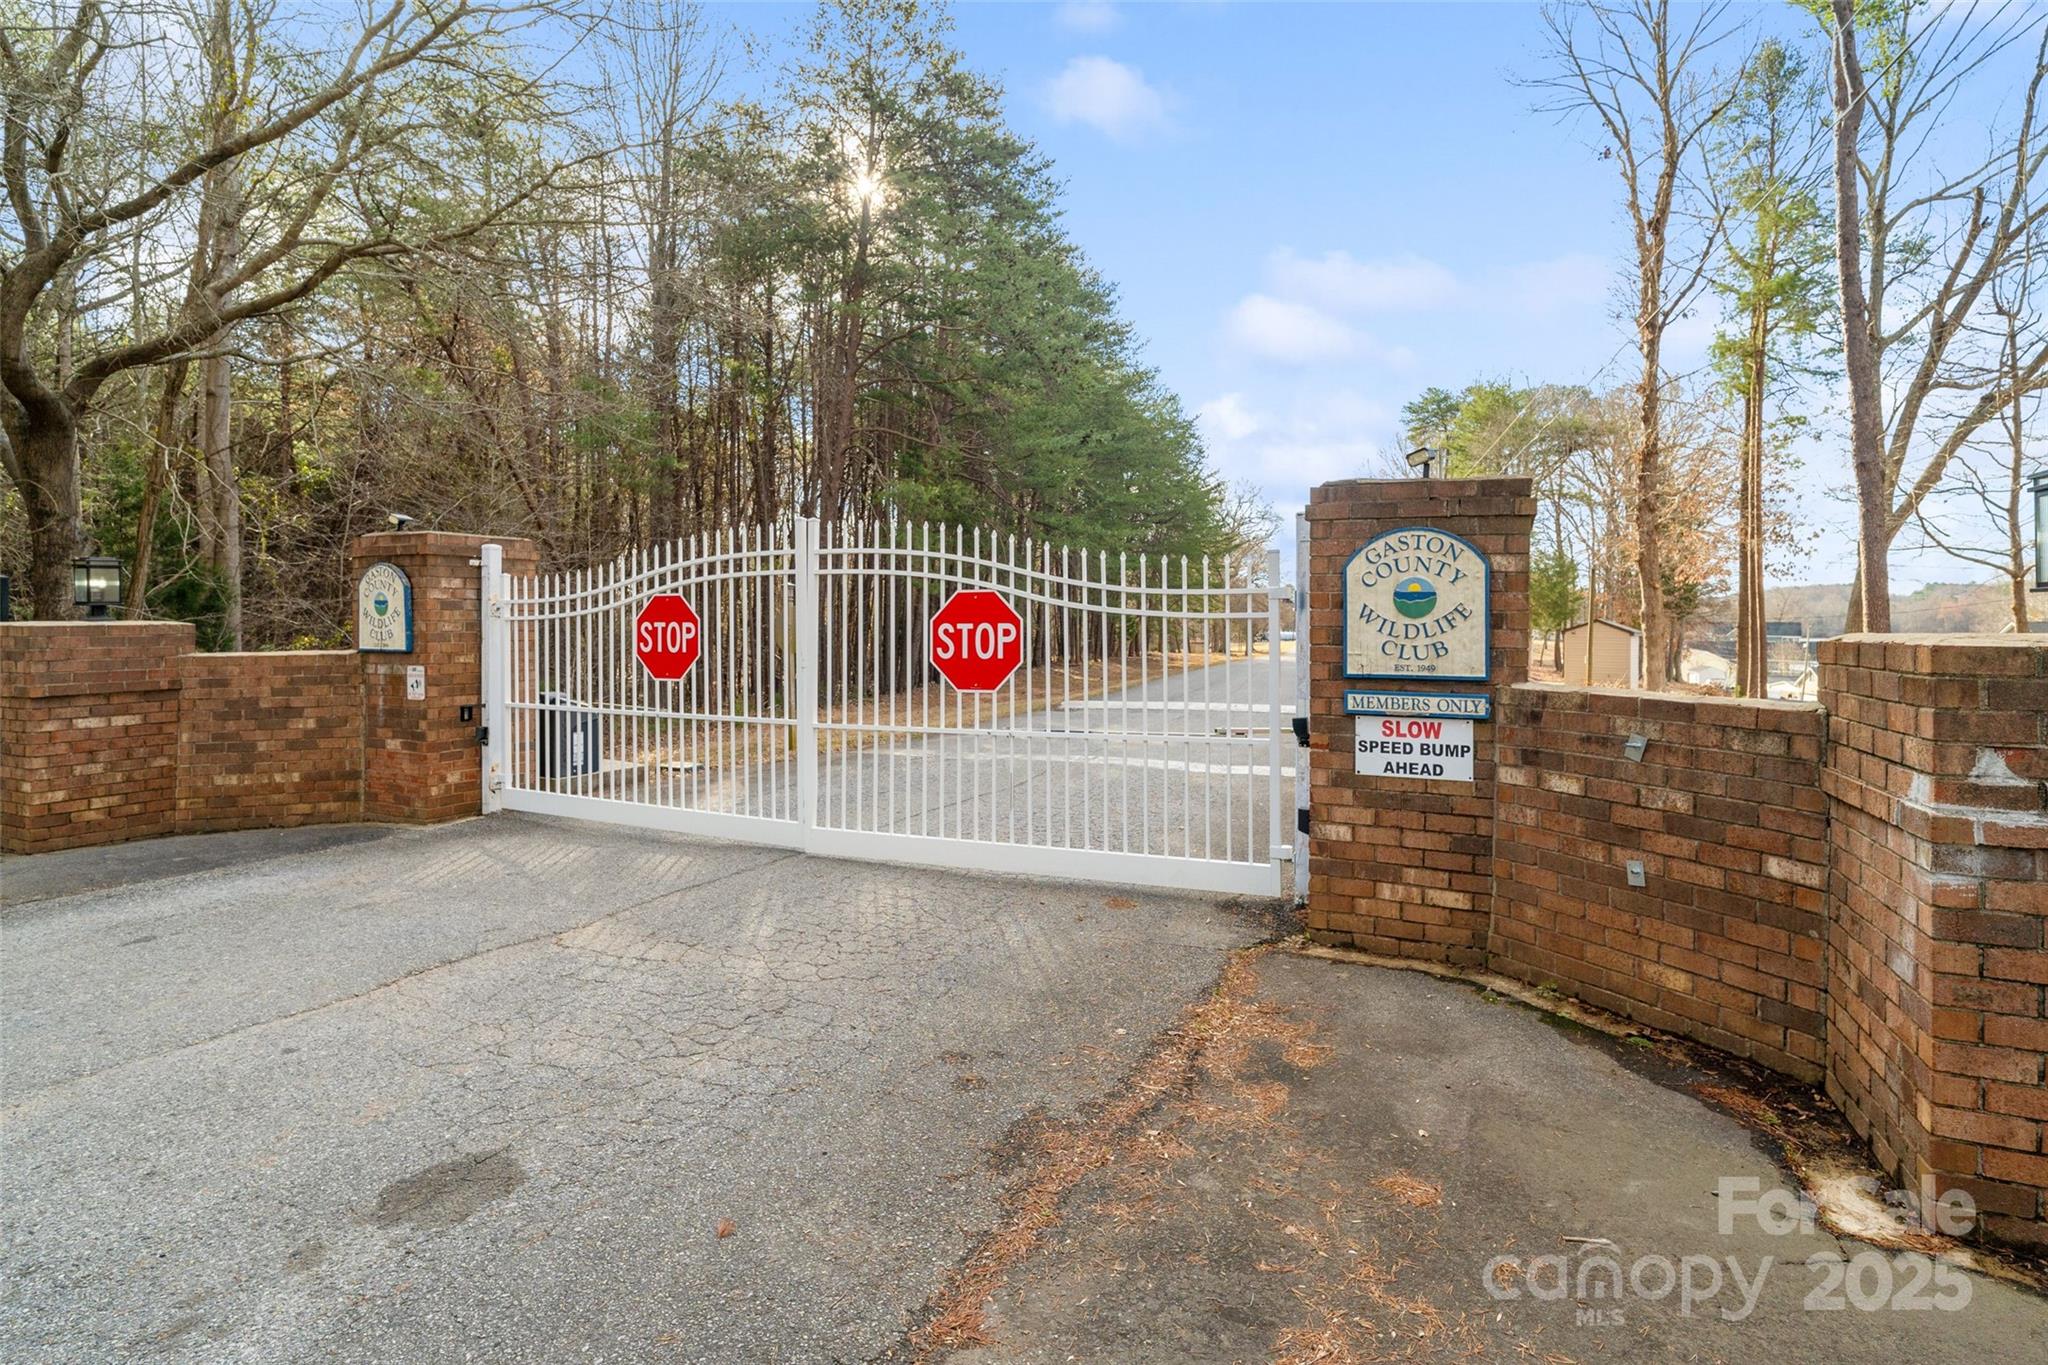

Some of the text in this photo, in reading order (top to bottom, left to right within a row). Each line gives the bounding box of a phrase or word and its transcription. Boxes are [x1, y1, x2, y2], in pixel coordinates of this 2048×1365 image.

[1365, 534, 1465, 565] GASTON
[365, 566, 397, 585] GASTON
[1361, 556, 1468, 588] COUNTY
[363, 579, 399, 598] COUNTY
[362, 606, 401, 629] WILDLIFE
[1359, 602, 1473, 640] WILDLIFE
[369, 628, 394, 642] CLUB
[639, 621, 696, 654] STOP
[936, 622, 1017, 660] STOP
[1381, 639, 1449, 661] CLUB
[1394, 664, 1436, 672] EST. 1949
[1352, 695, 1483, 714] MEMBERS ONLY
[1381, 719, 1443, 739] SLOW
[1358, 739, 1471, 758] SPEED BUMP
[1383, 761, 1444, 776] AHEAD
